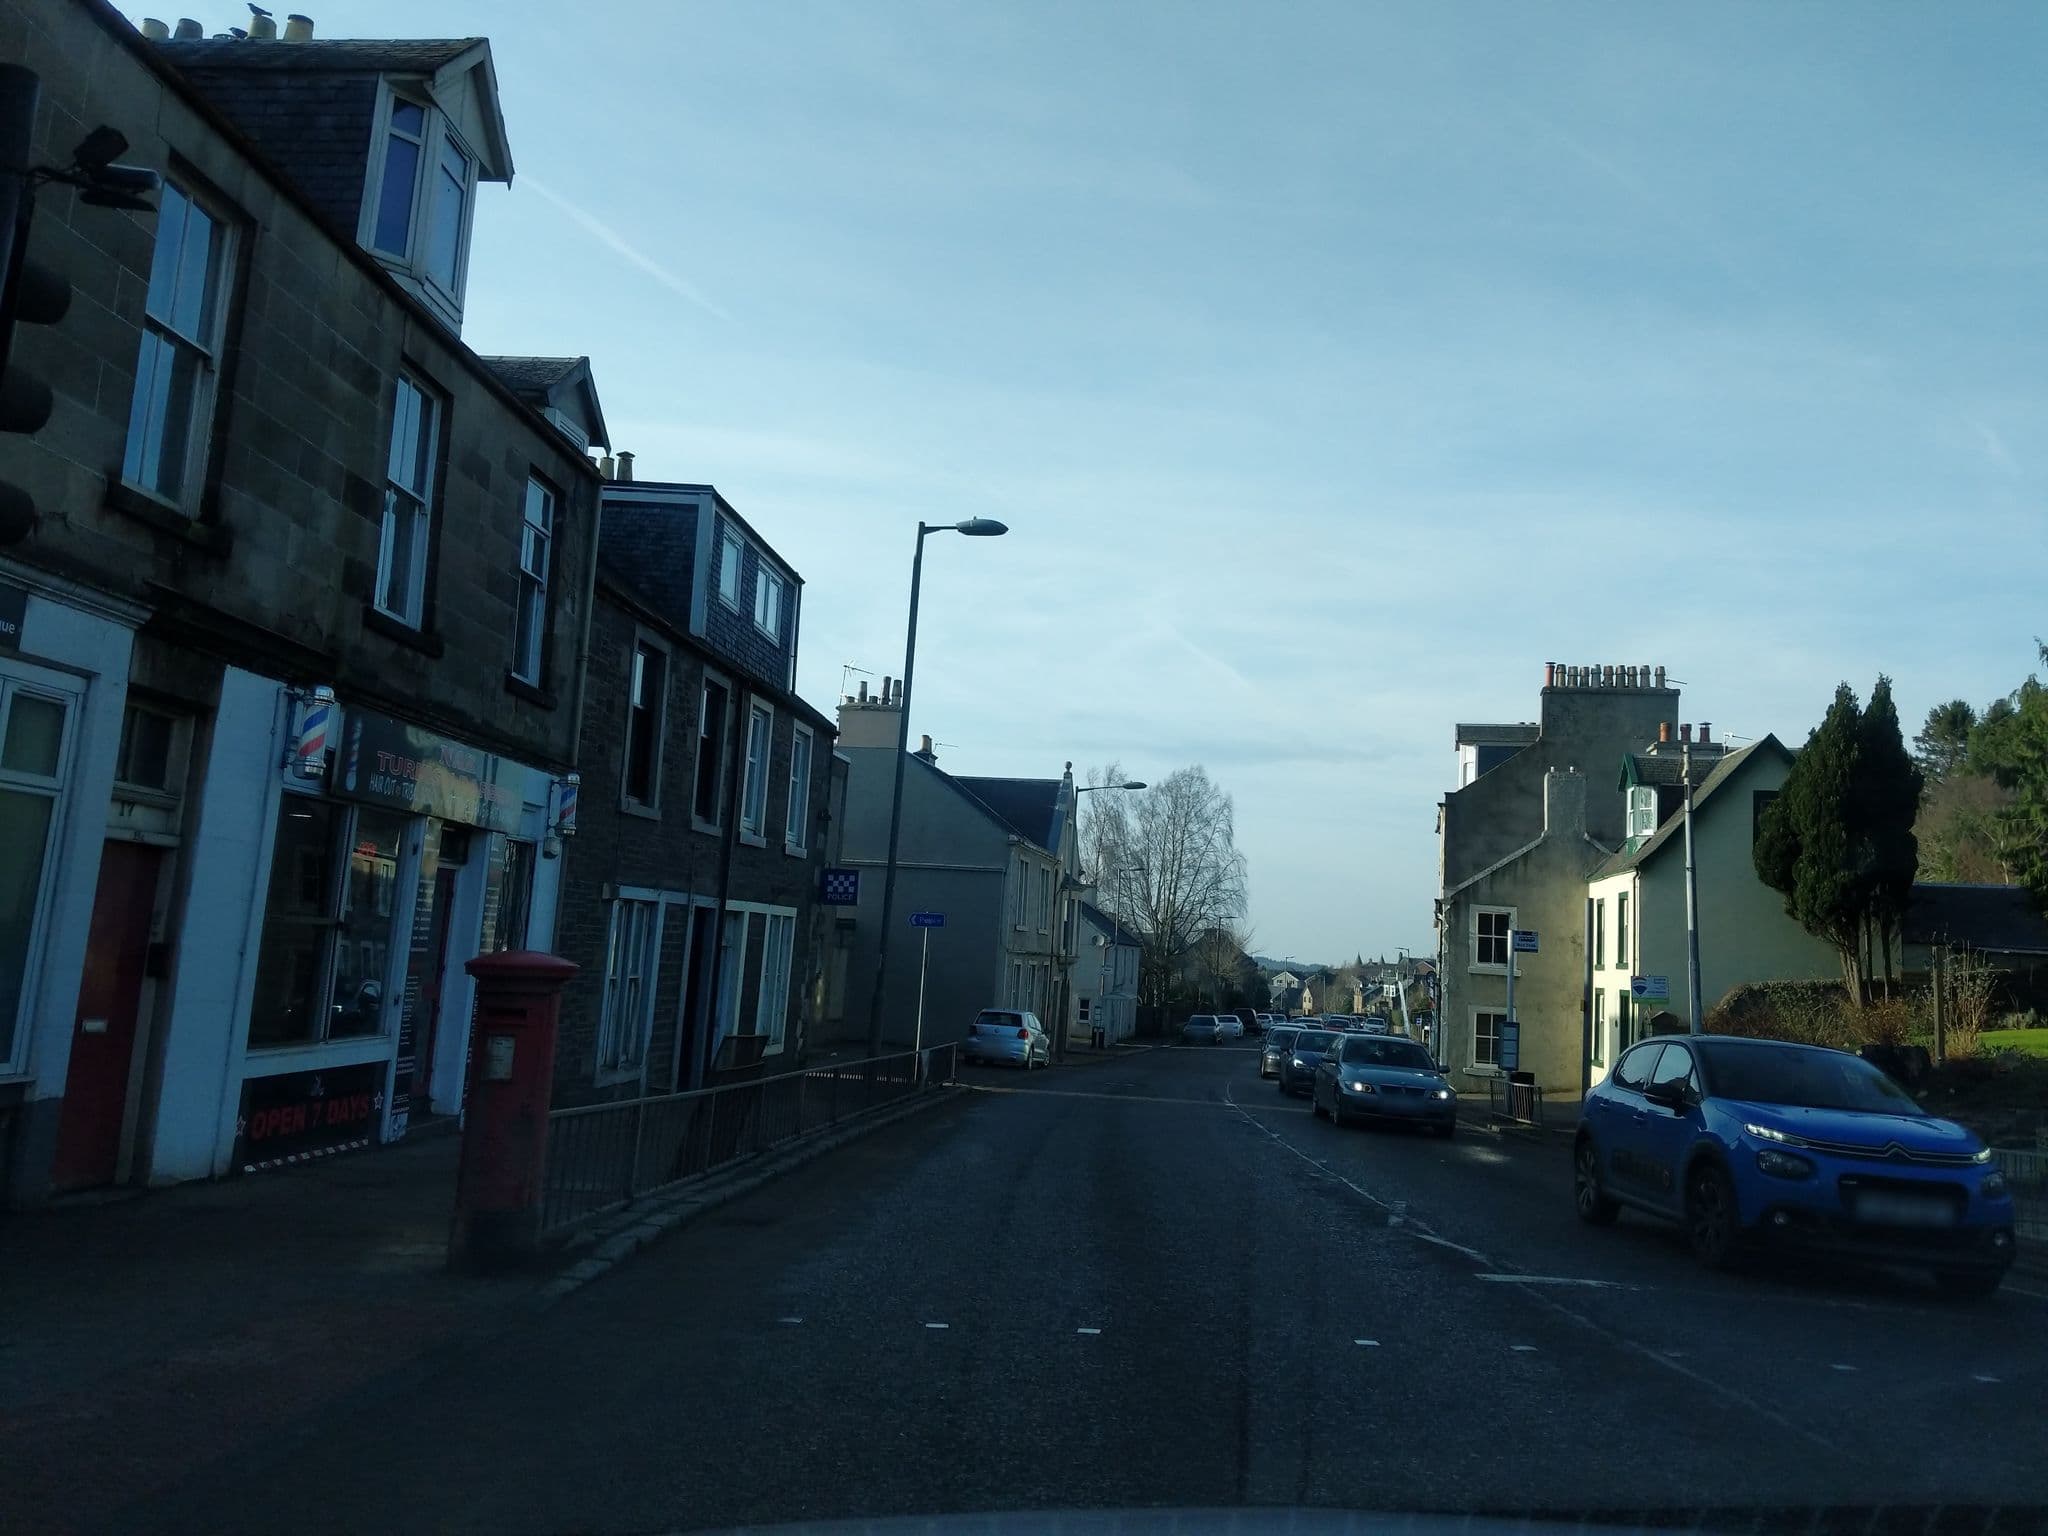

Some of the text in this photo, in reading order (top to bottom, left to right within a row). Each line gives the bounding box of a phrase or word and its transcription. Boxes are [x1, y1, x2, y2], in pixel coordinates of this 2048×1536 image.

[376, 749, 451, 787] TURKS
[250, 1103, 305, 1140] OPEN
[311, 1100, 321, 1128] 7
[327, 1093, 368, 1124] DAYS
